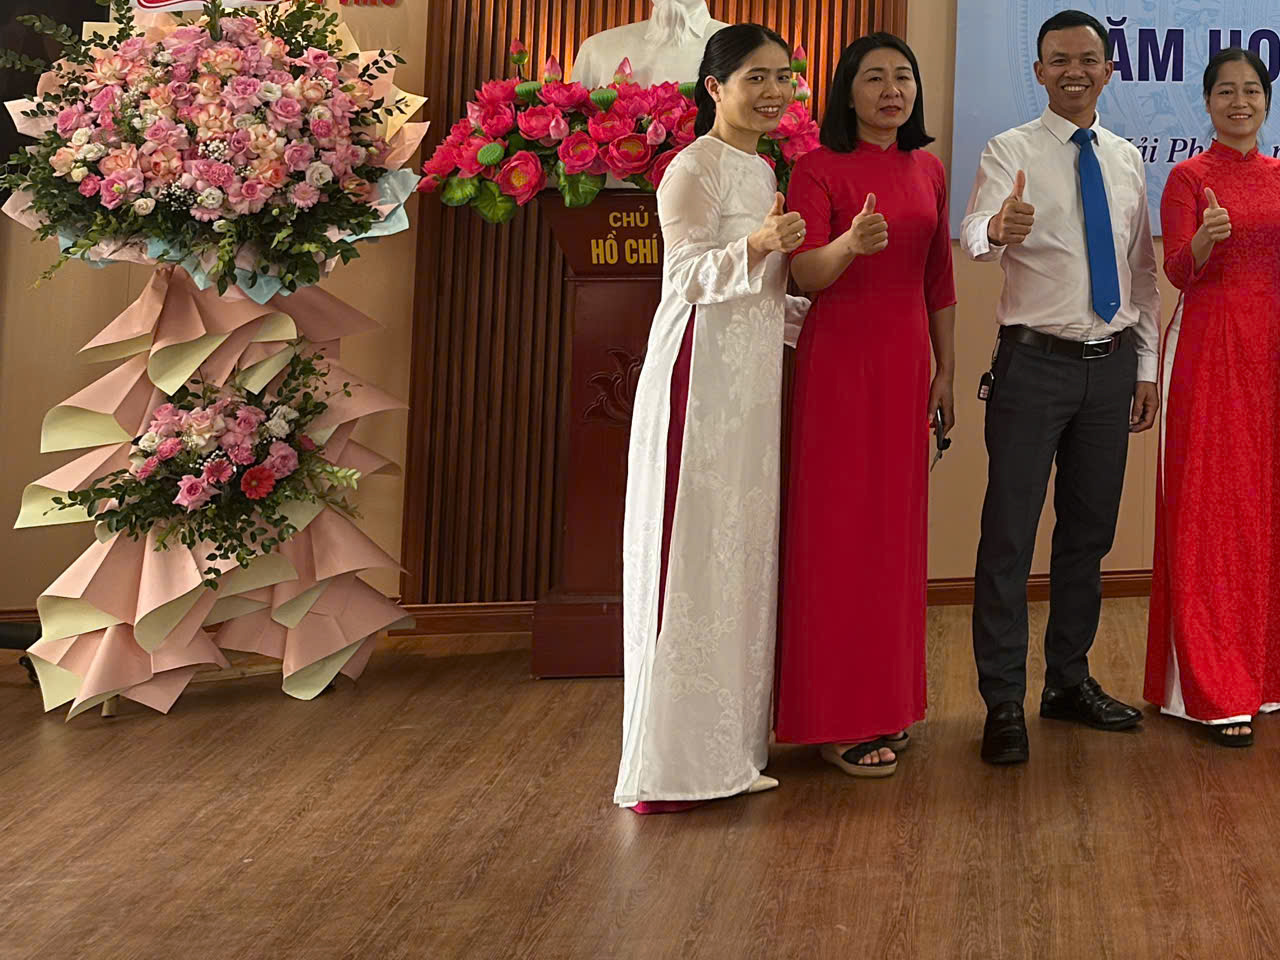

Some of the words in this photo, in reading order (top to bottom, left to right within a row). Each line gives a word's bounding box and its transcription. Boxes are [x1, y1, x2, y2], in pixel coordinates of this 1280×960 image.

[1106, 16, 1184, 82] ĂM
[1124, 136, 1159, 163] ải
[609, 205, 649, 228] CHỦ
[591, 230, 619, 264] HỒ
[625, 233, 659, 264] CHÍ
